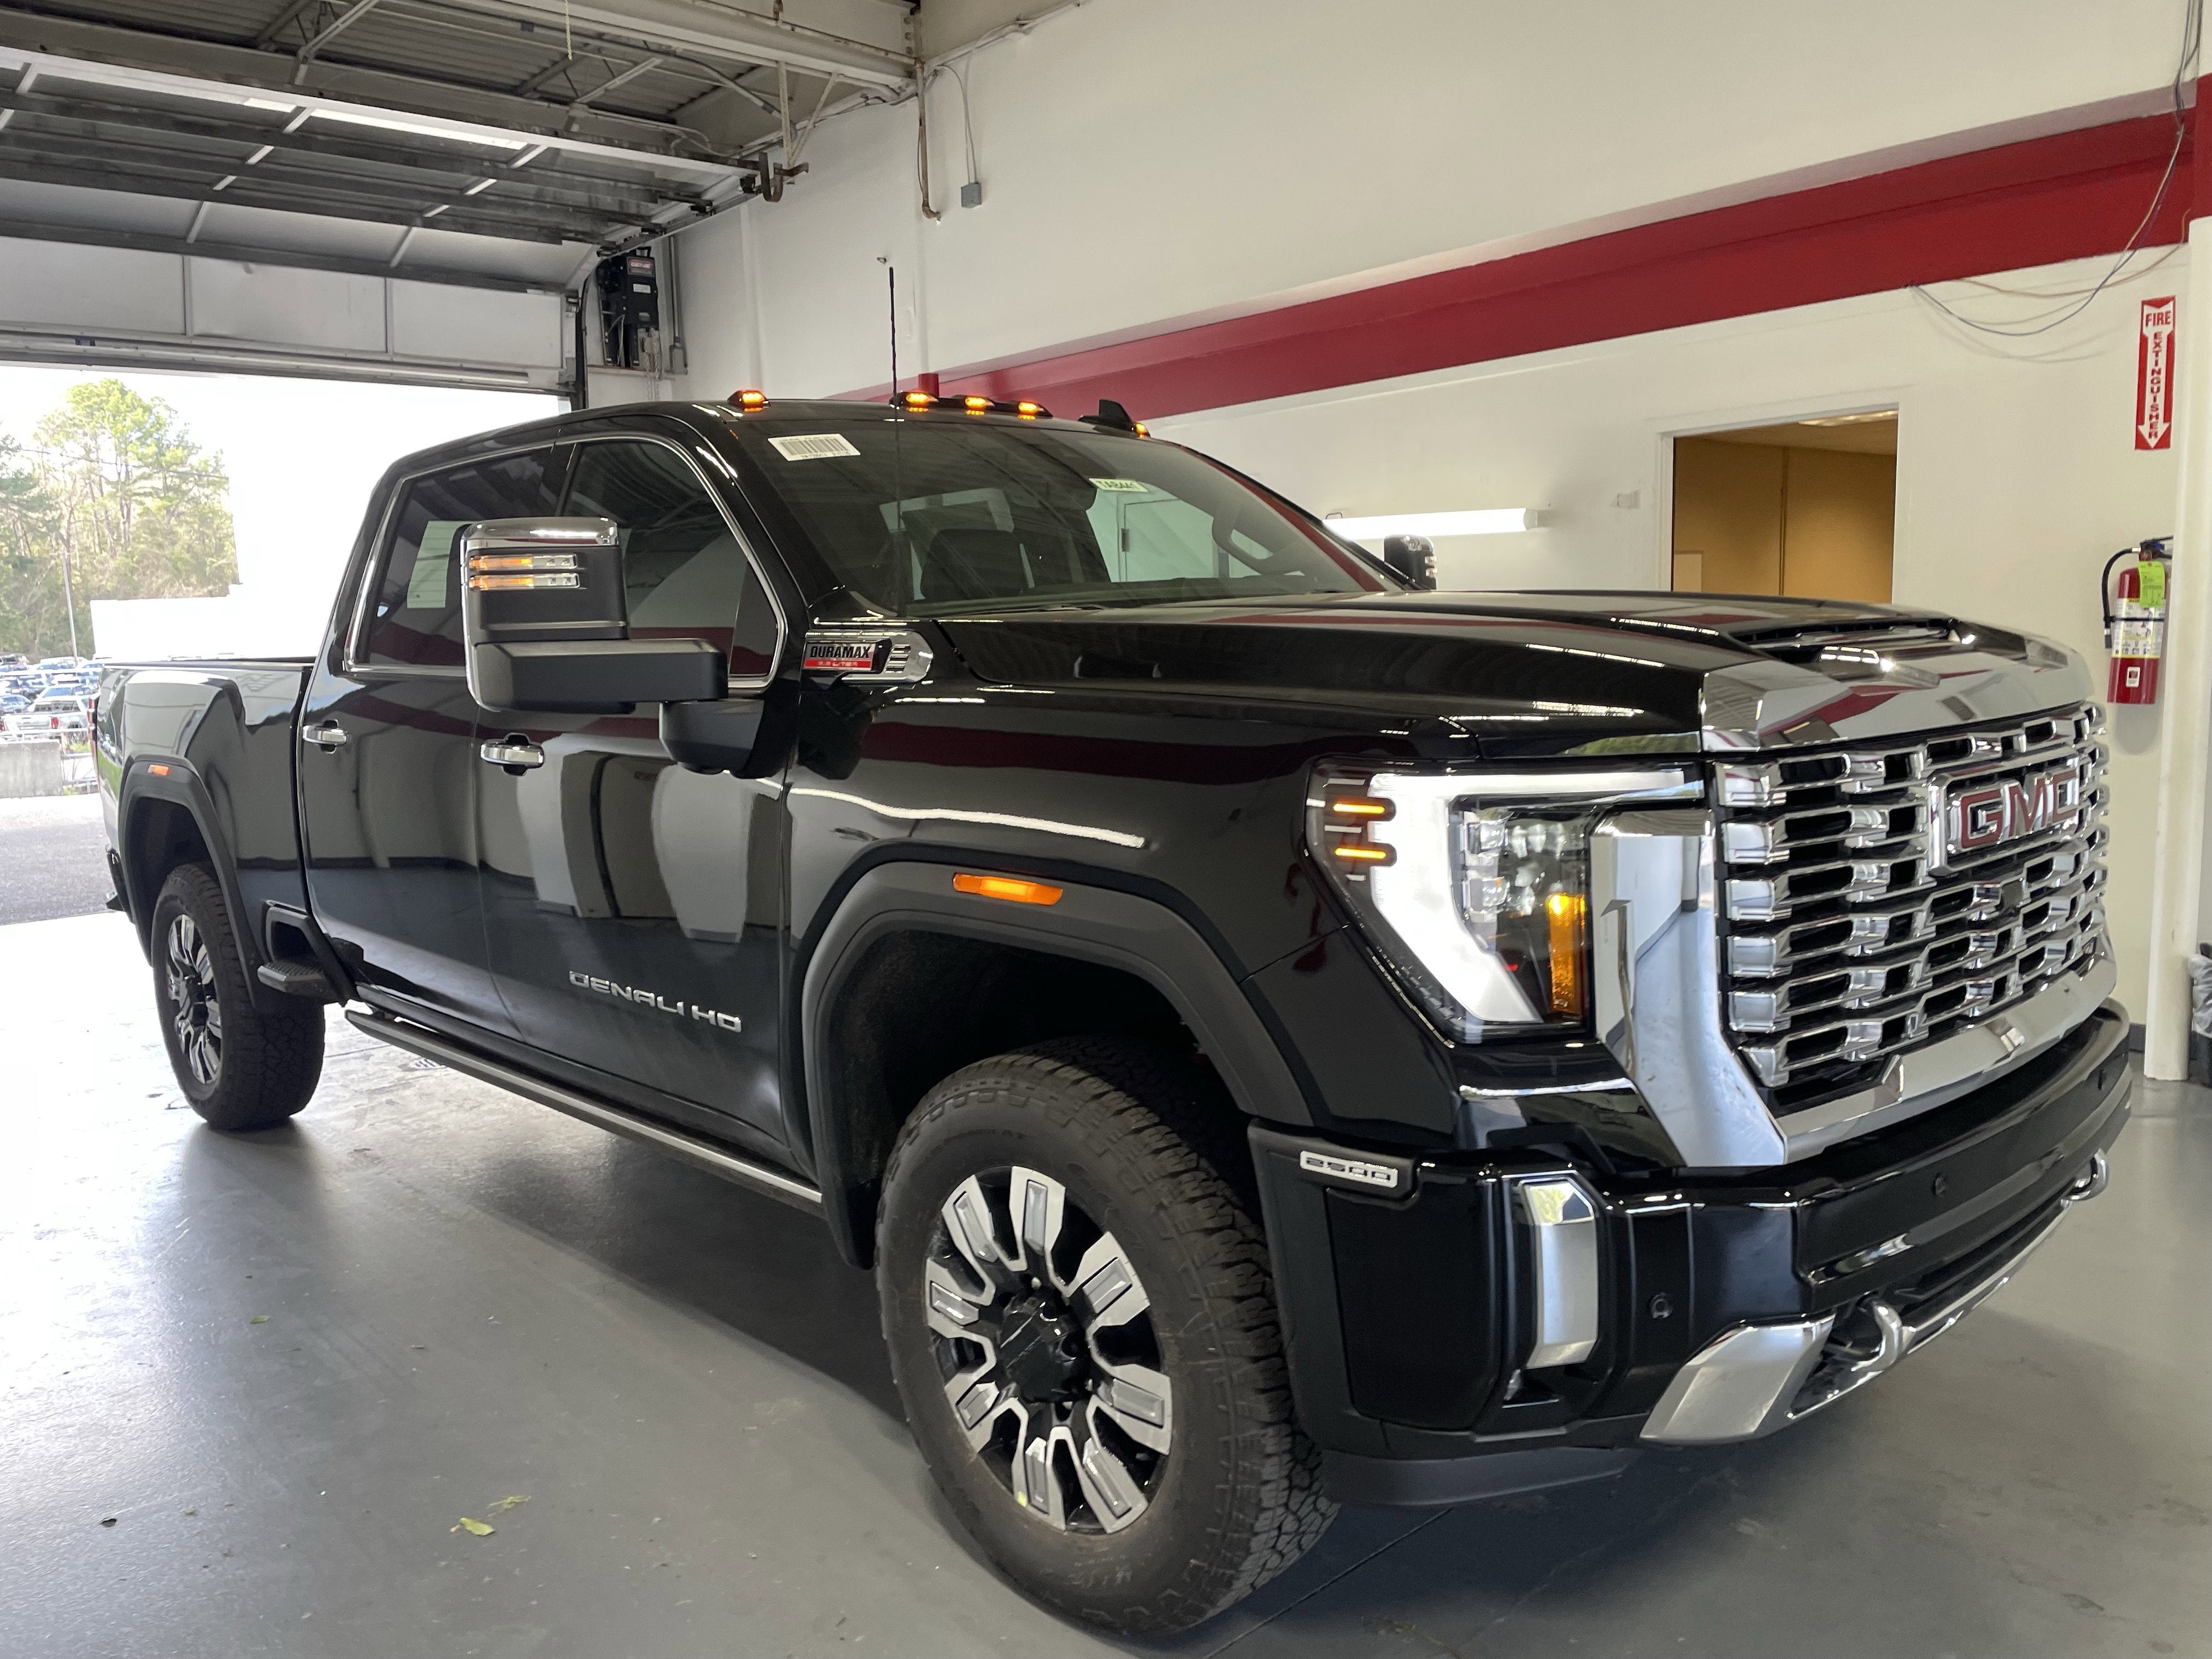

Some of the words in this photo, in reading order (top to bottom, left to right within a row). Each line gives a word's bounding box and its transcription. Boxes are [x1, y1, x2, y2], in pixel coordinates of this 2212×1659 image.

[2145, 311, 2171, 327] FIRE
[2148, 331, 2163, 438] EXTINGUISHER
[810, 645, 871, 658] DURAMAX
[1956, 768, 2079, 850] GMC
[569, 970, 685, 1015] DENALI
[691, 1005, 742, 1033] HD
[1304, 1155, 1393, 1183] 2500
